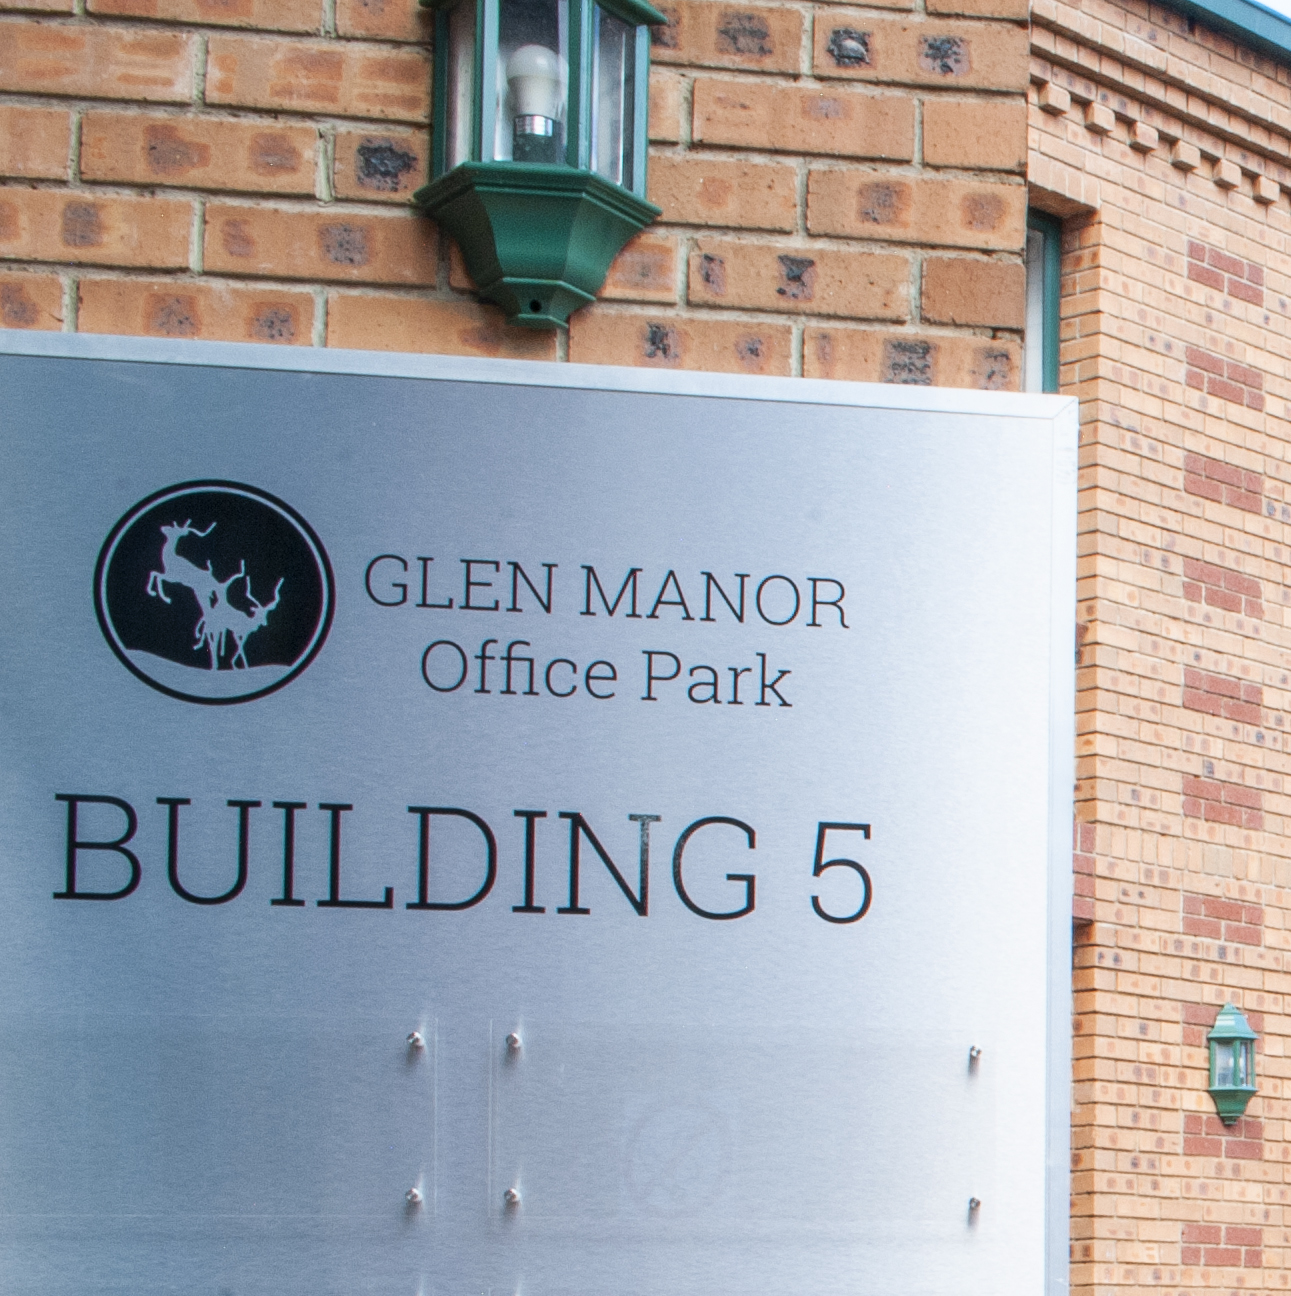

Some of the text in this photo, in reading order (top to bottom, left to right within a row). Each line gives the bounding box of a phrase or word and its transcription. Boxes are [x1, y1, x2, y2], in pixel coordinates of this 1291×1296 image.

[363, 552, 850, 630] GLEN MANOR
[419, 637, 794, 708] Office Park
[51, 791, 873, 925] BUILDING 5
